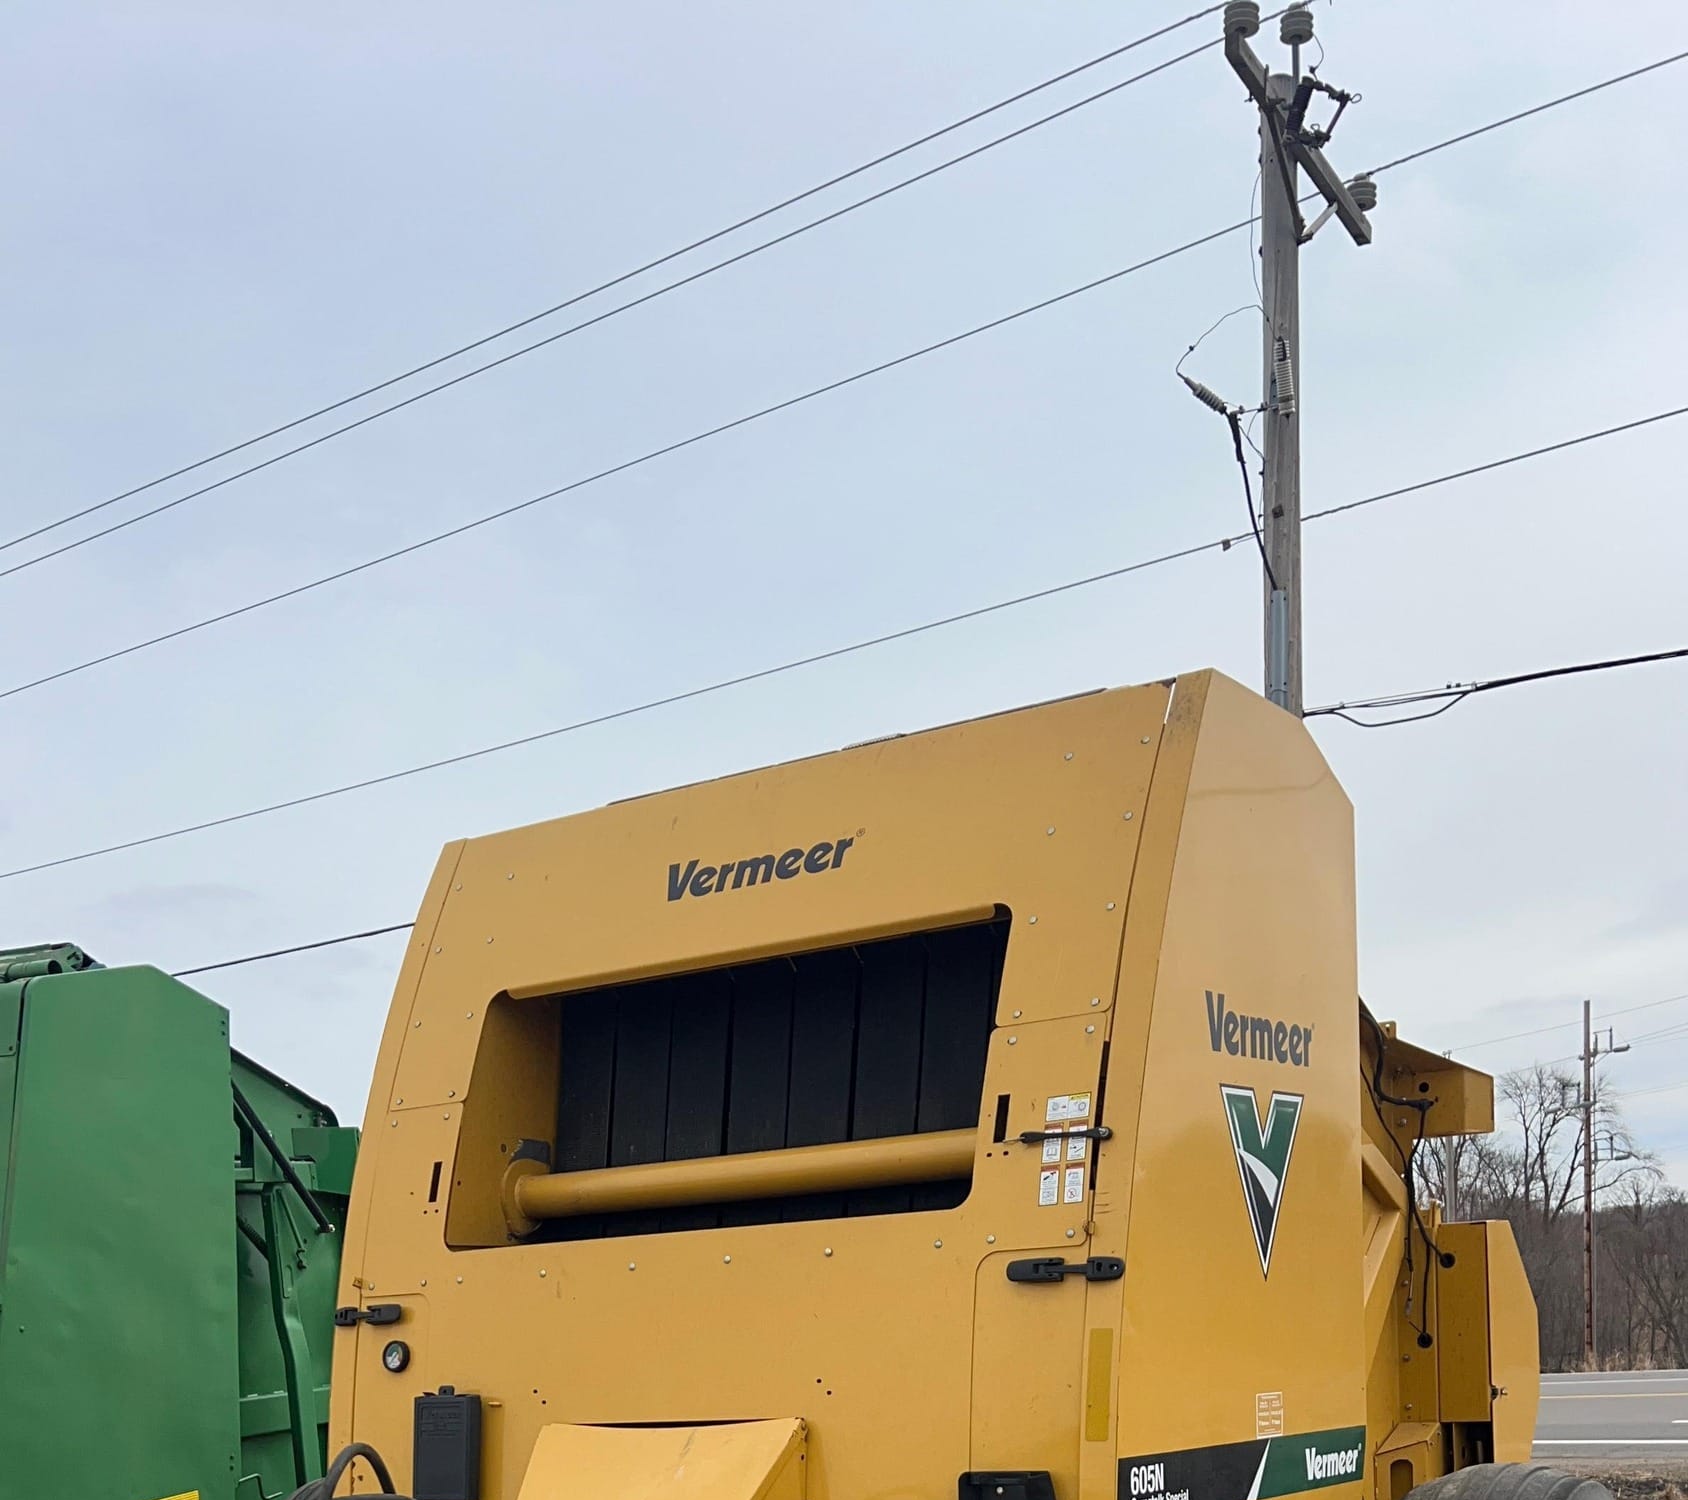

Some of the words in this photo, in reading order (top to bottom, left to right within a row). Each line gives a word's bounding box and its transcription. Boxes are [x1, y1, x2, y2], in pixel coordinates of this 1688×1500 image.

[667, 836, 854, 902] Vermeer
[1205, 990, 1312, 1067] Vermeer
[1130, 1462, 1164, 1496] 605N
[1305, 1447, 1359, 1481] Vermeer
